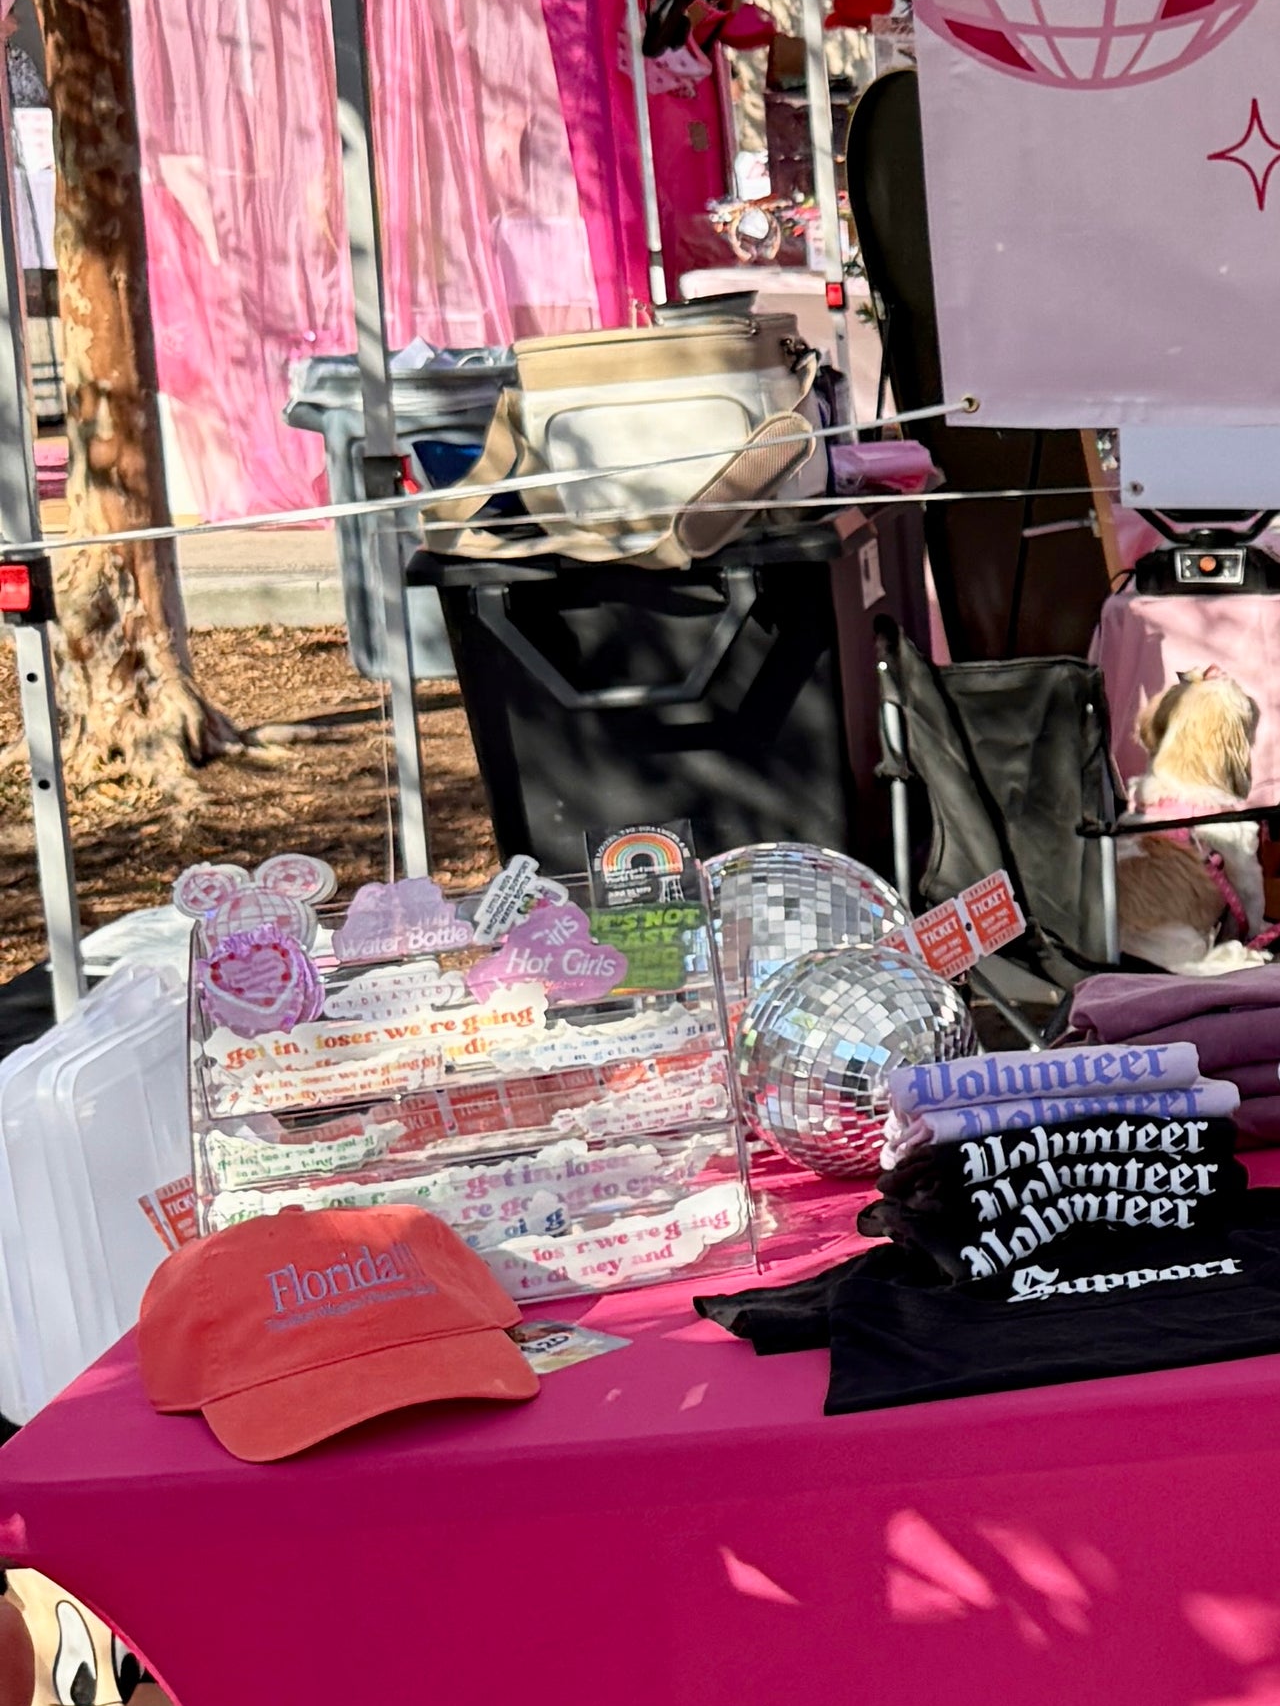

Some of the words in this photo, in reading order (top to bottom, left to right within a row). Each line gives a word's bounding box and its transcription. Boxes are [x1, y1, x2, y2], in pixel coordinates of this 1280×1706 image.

[644, 908, 700, 927] NOT
[971, 888, 1008, 918] TICKET
[407, 924, 469, 951] Bottle
[921, 916, 959, 947] TICKET
[505, 947, 553, 975] Hot
[561, 947, 617, 977] Girls
[908, 1046, 1168, 1107] Volunteer
[960, 1120, 1208, 1186] Volunteer
[971, 1157, 1219, 1222] Volunteer
[663, 1207, 732, 1240] ging
[960, 1191, 1198, 1282] Volunteer
[546, 1258, 623, 1282] diney
[1006, 1258, 1243, 1303] Support
